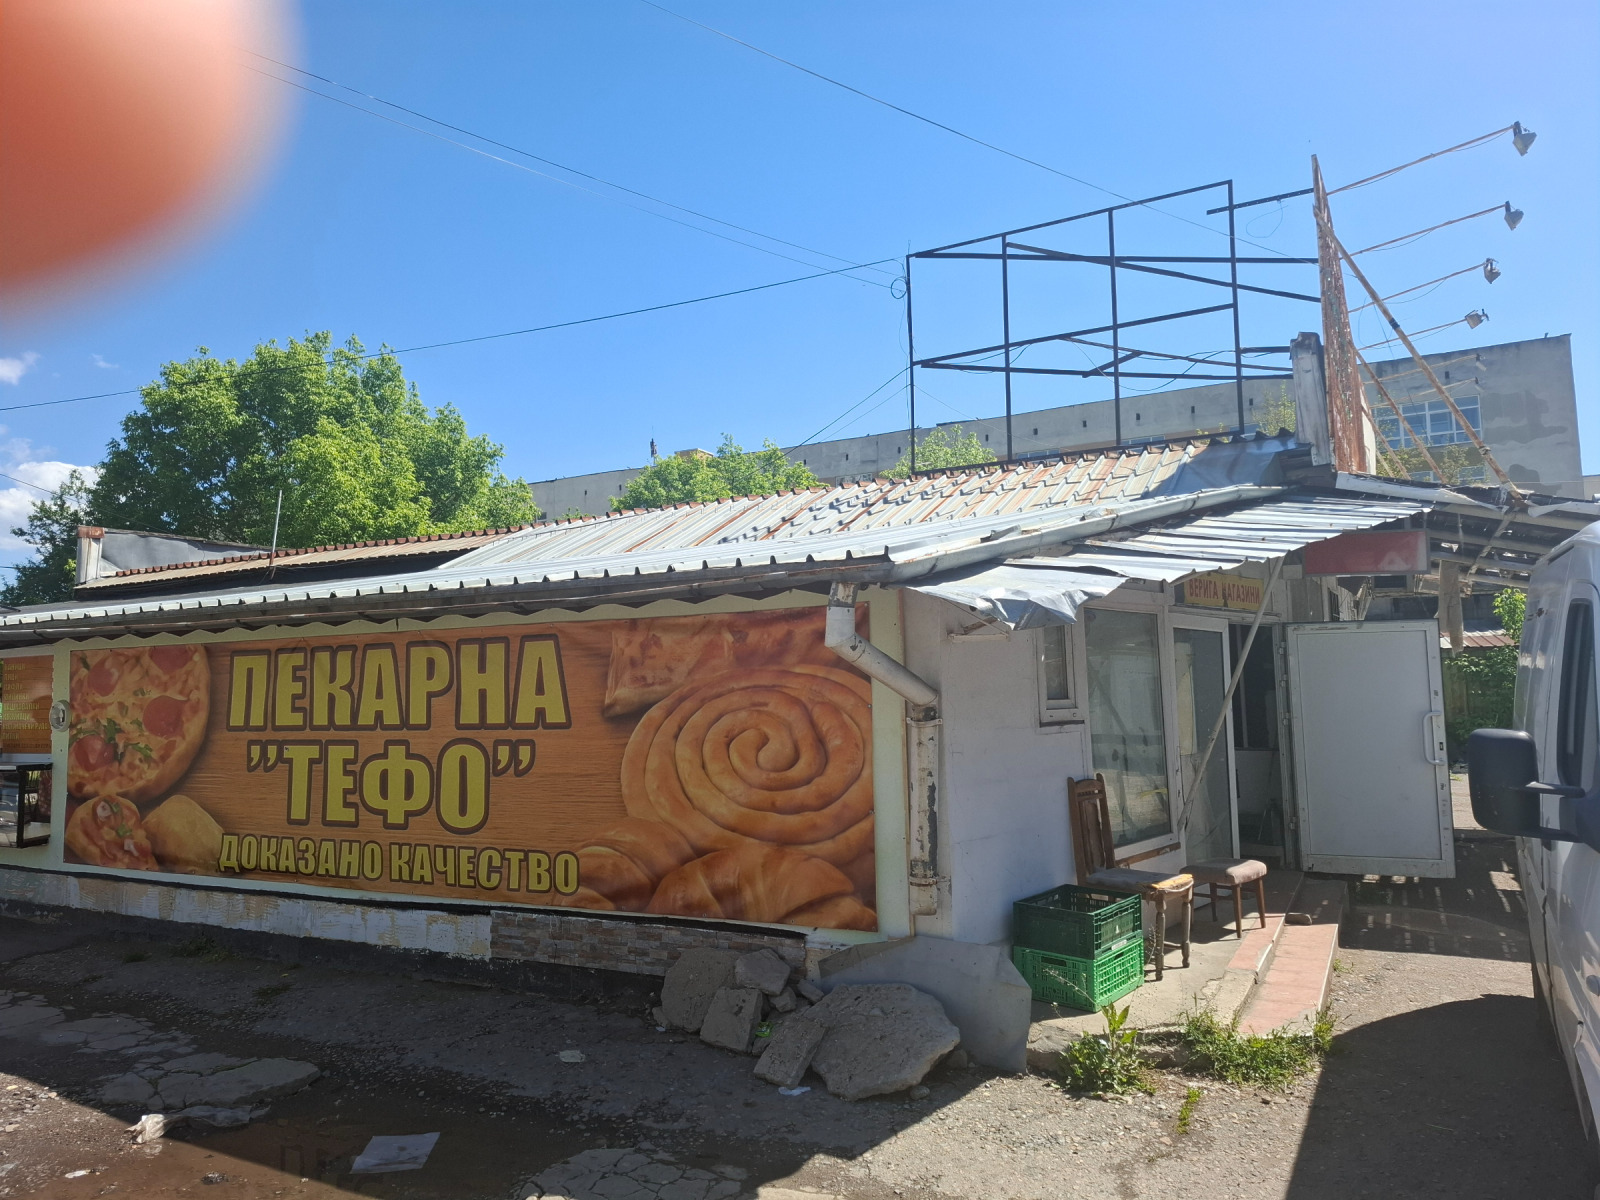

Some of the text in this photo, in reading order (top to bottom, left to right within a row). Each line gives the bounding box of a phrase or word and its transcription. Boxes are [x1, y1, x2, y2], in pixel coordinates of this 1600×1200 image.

[1189, 578, 1219, 599] ВЕРИГА
[227, 635, 571, 730] ПЕКАРНА
[219, 834, 579, 894] ДОКАЗАНО КАЧЕСТВО
